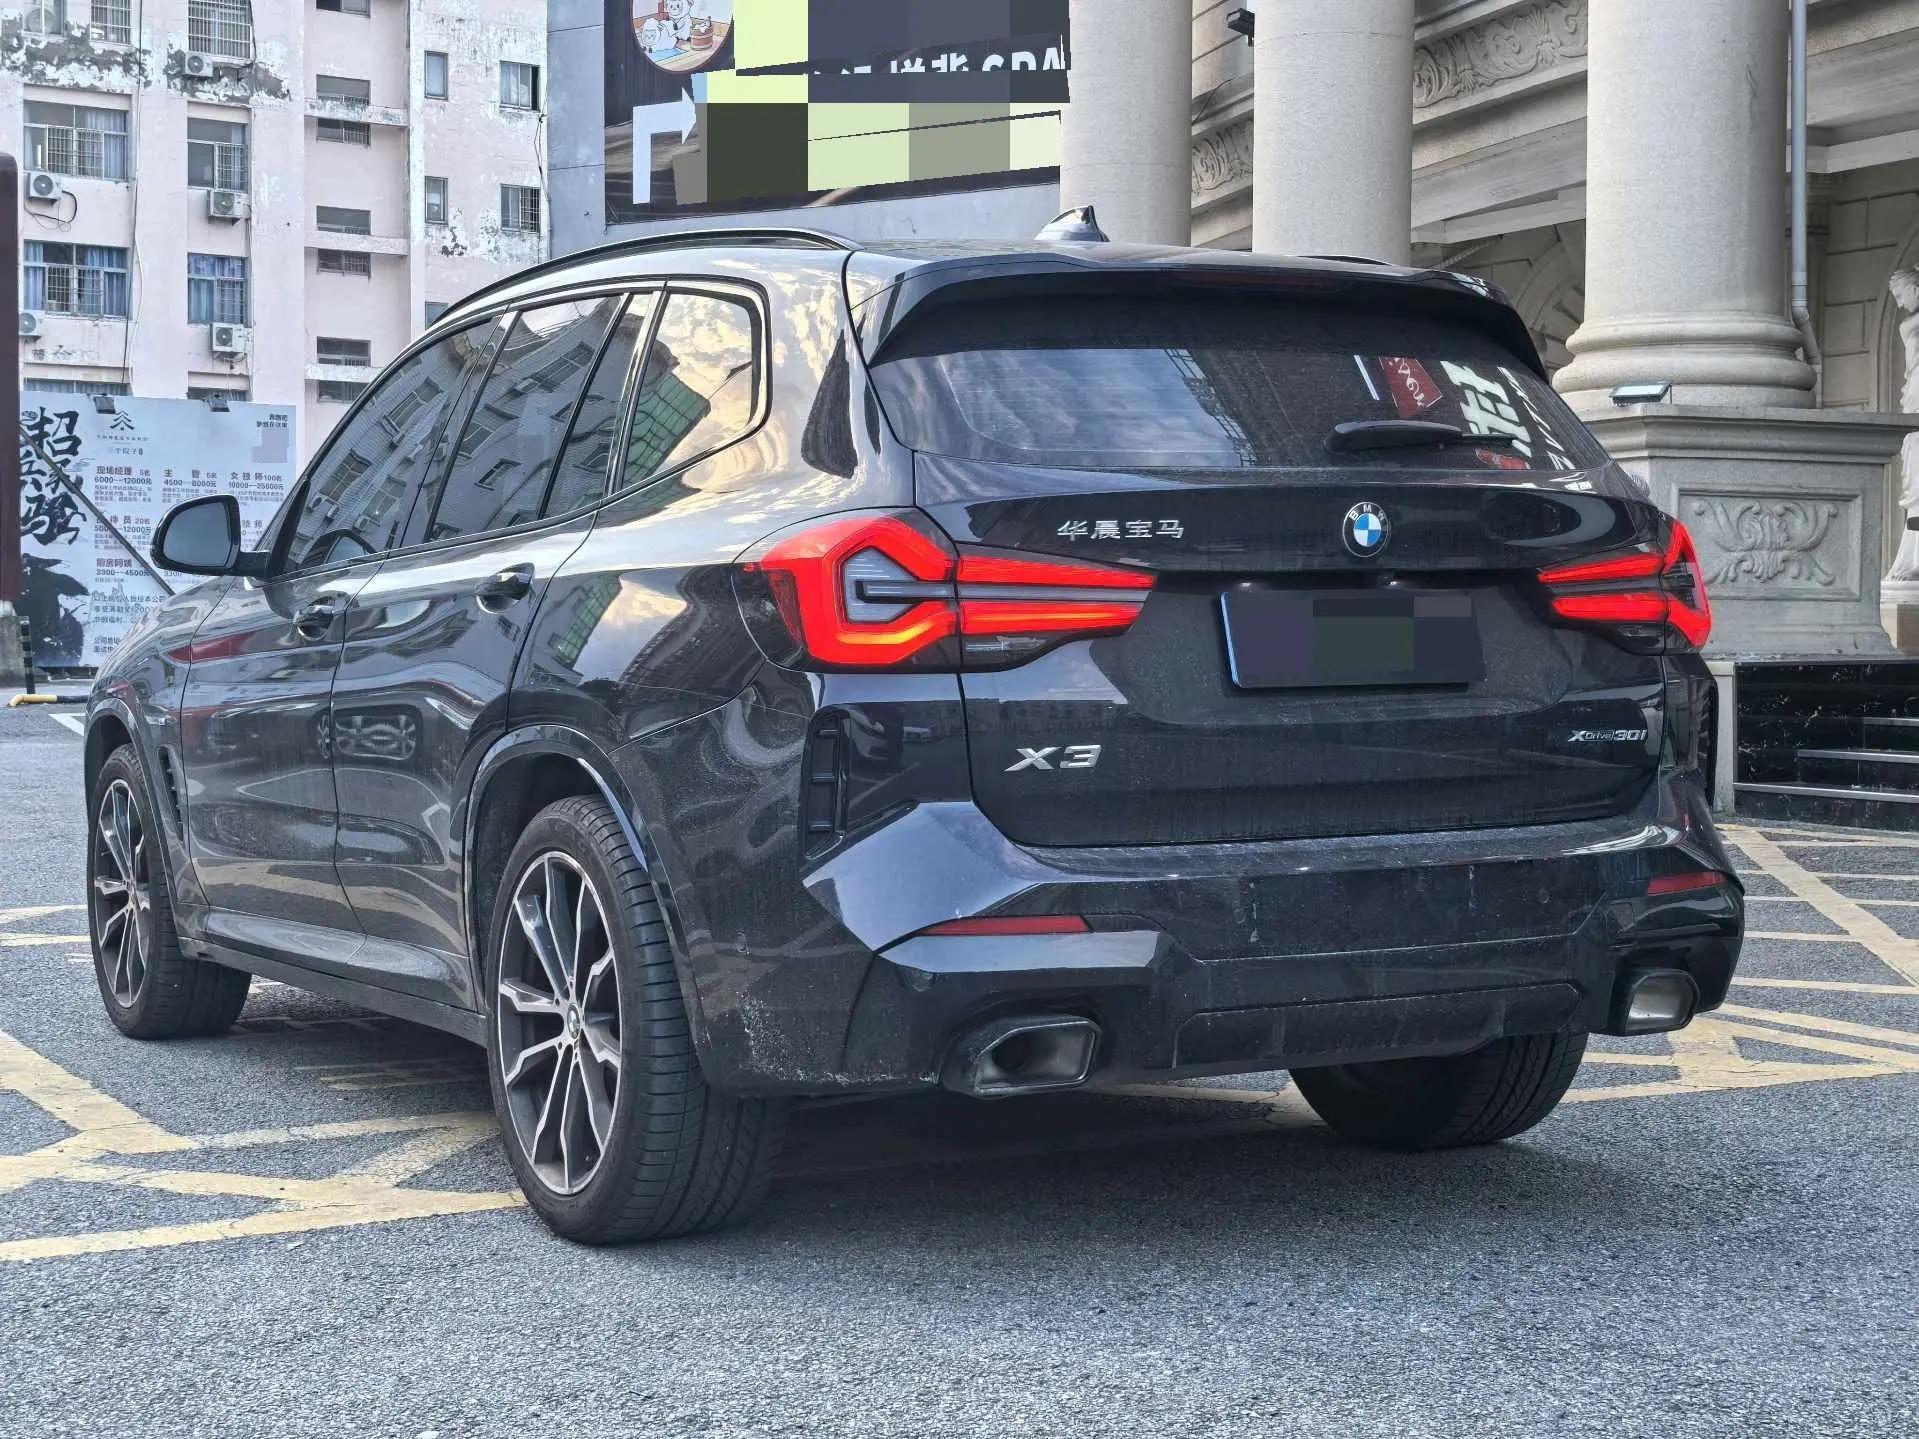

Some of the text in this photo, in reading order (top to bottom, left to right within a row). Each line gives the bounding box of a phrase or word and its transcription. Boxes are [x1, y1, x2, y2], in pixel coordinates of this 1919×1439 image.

[96, 465, 132, 476] 现场经理
[1057, 520, 1184, 541] 华晨宝马
[1003, 744, 1102, 773] X3
